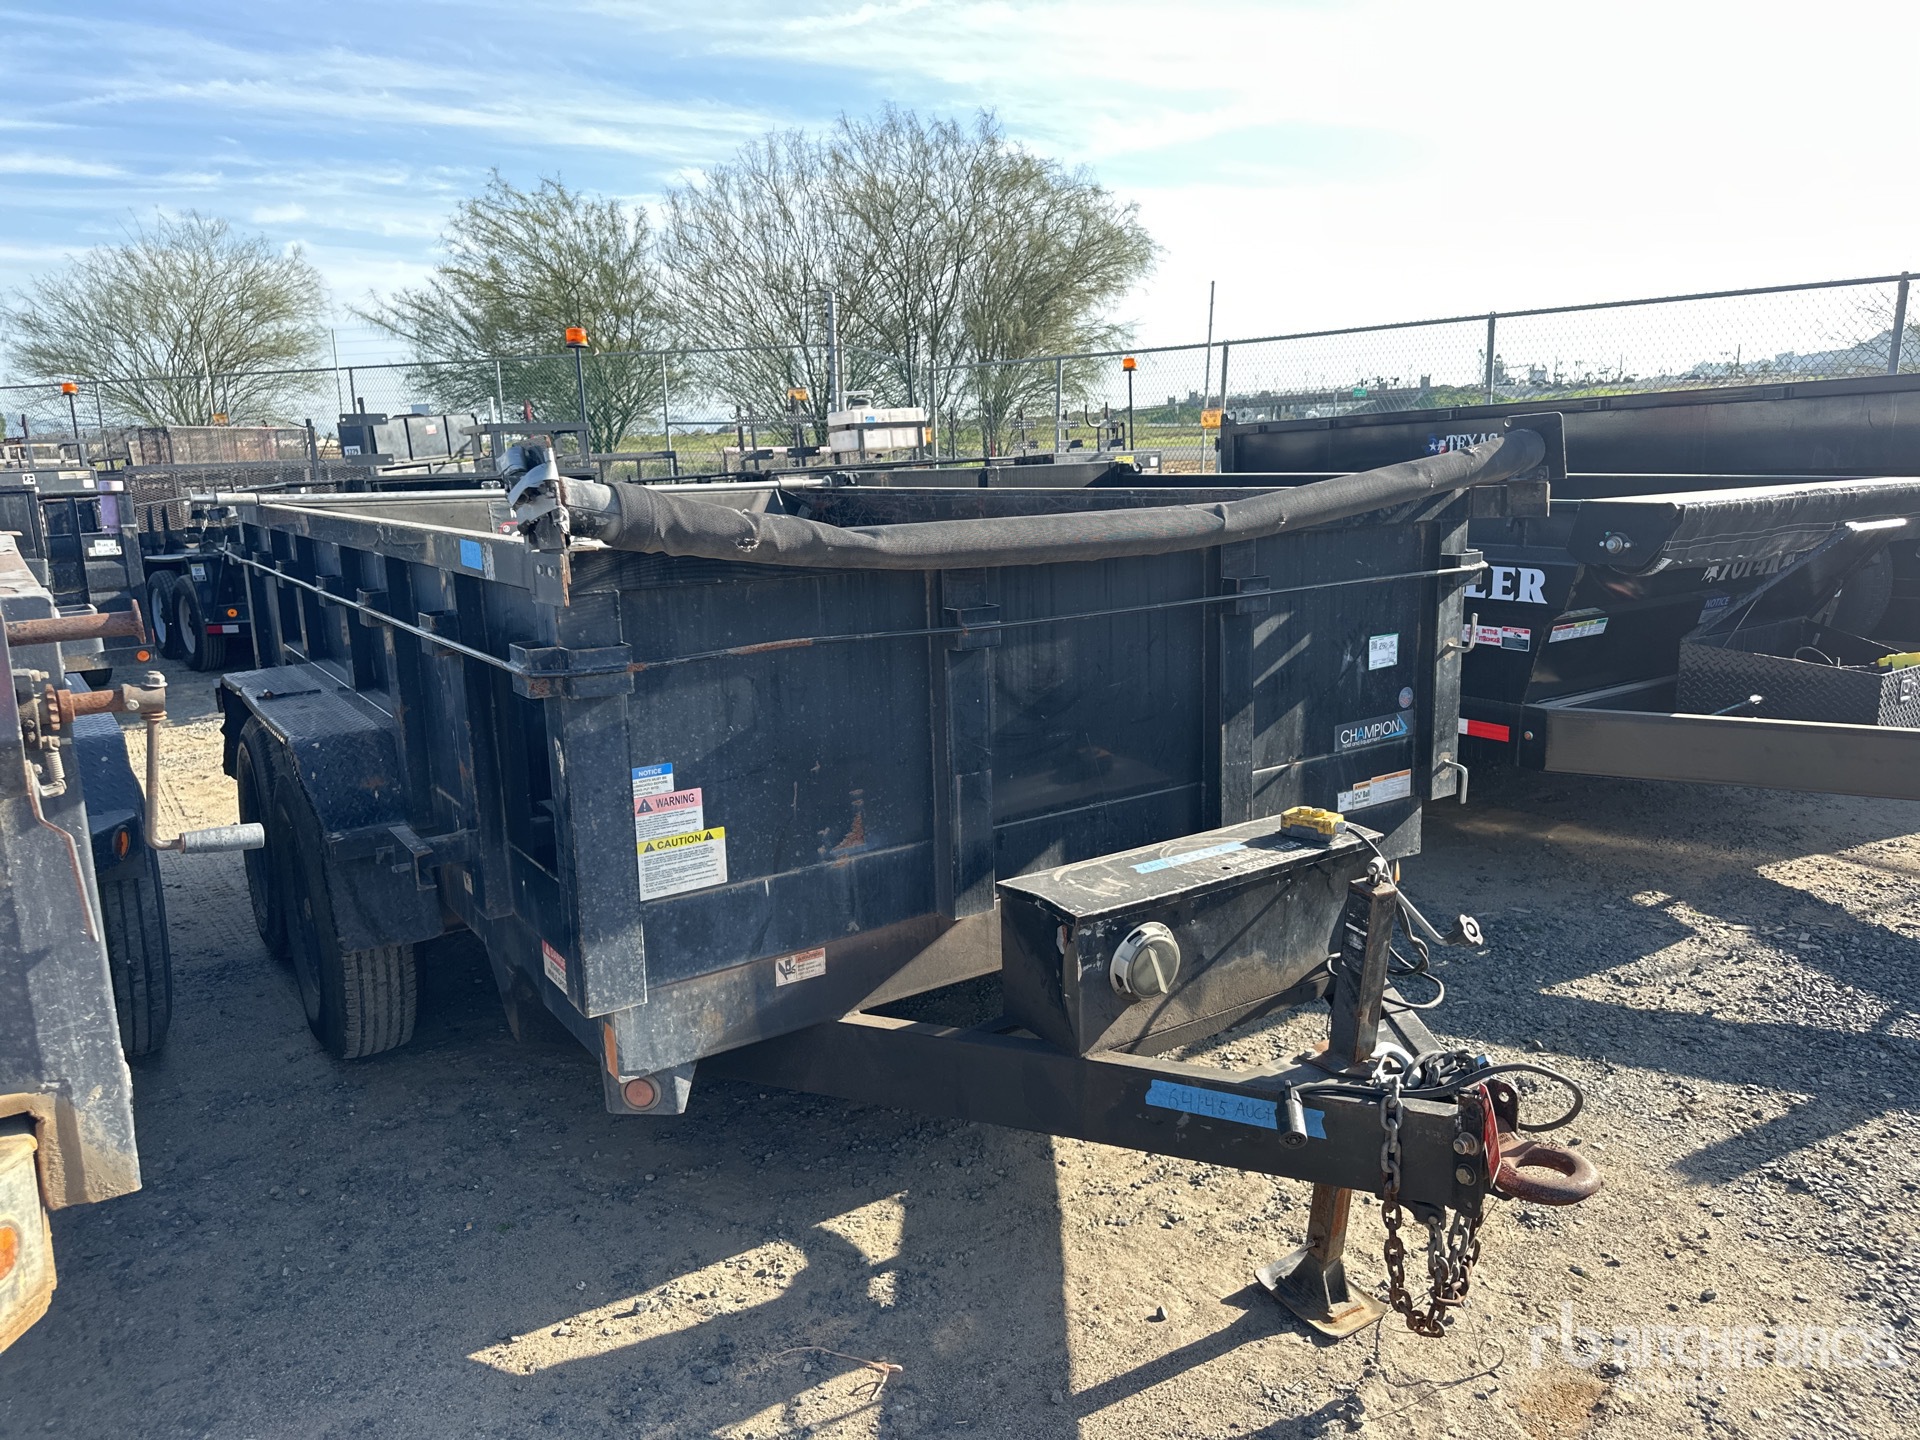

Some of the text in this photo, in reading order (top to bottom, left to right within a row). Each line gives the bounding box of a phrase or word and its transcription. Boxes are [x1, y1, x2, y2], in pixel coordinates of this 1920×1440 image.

[1704, 596, 1731, 608] NOTICE
[1340, 719, 1400, 744] CHAMPION
[638, 767, 662, 777] NOTICE
[656, 793, 695, 808] WARNING
[657, 834, 702, 849] CAUTION
